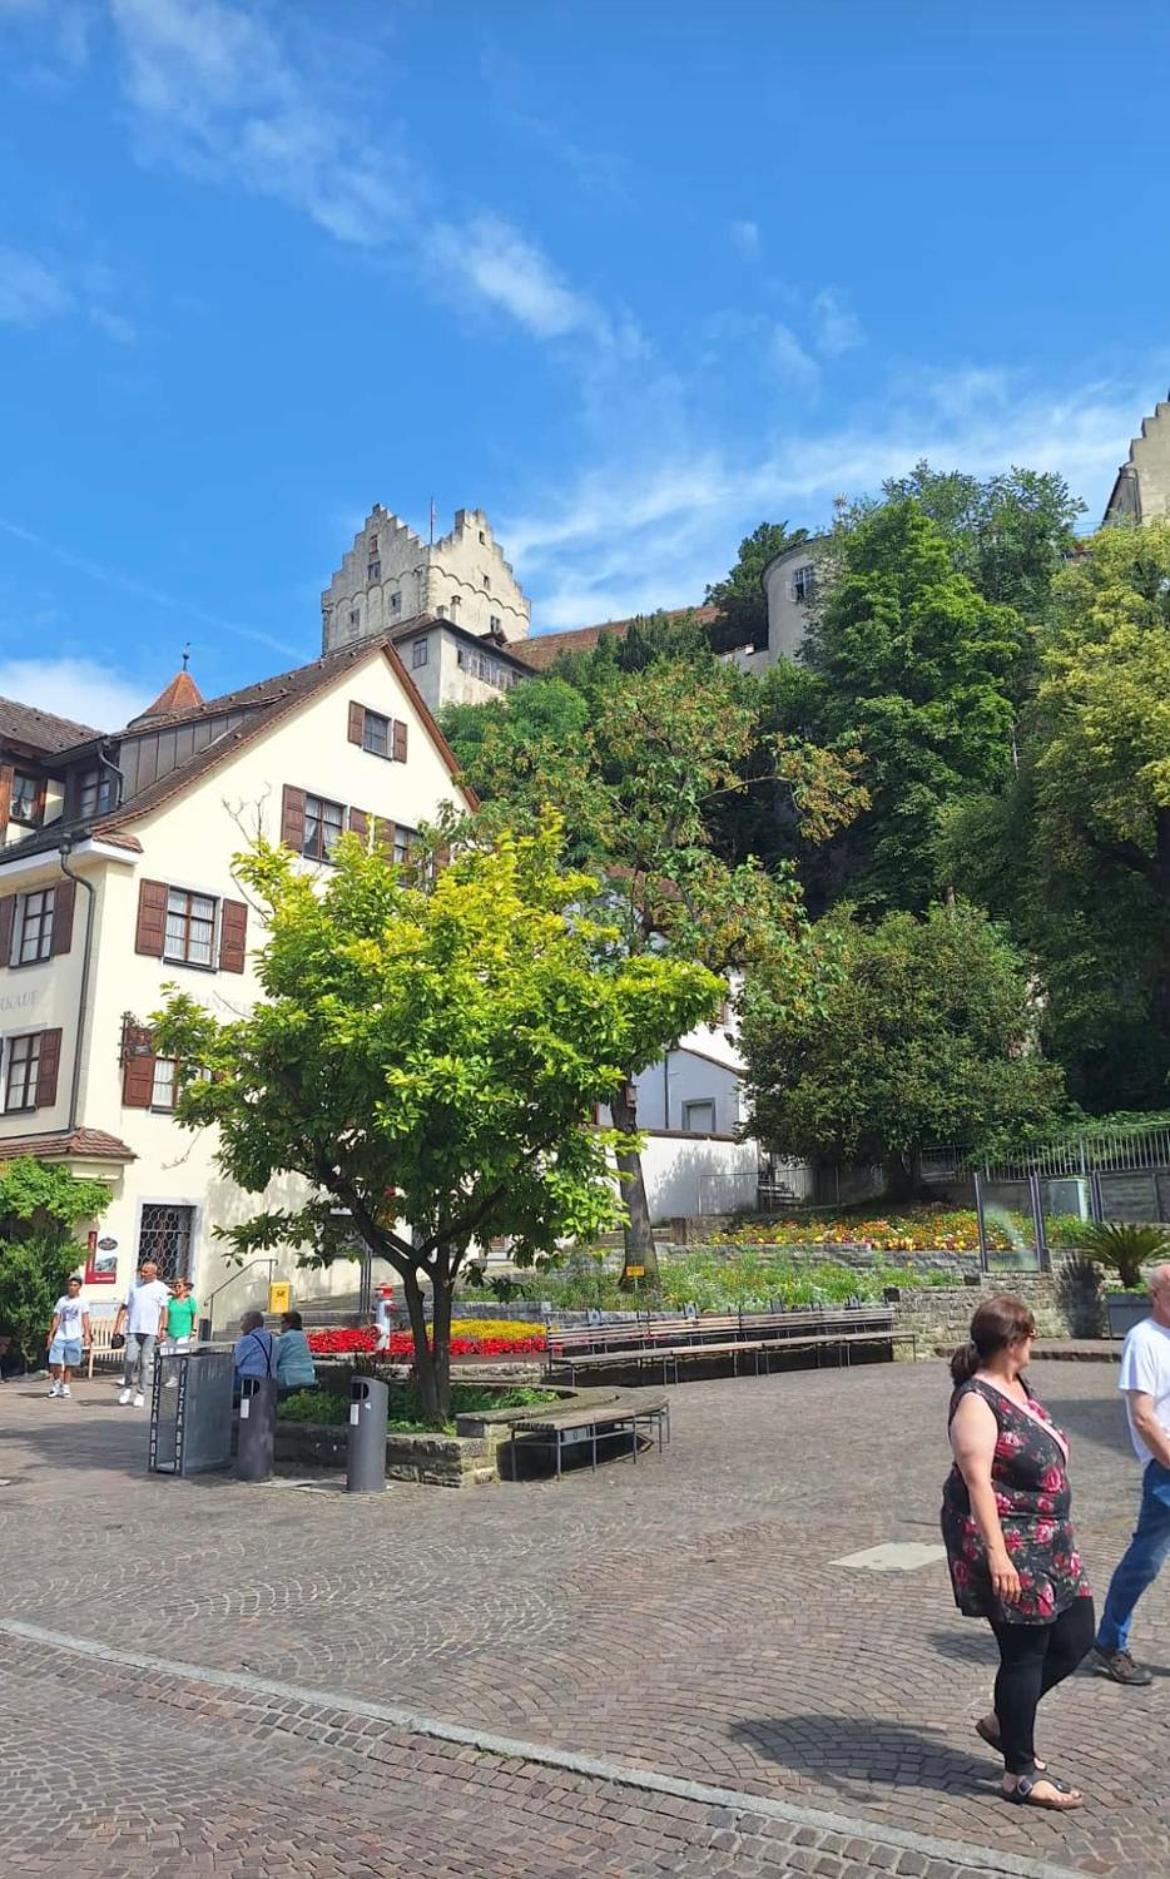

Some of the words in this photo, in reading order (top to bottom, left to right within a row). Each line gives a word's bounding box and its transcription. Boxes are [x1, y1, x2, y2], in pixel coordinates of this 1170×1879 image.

[152, 1359, 162, 1424] PIZZA
[177, 1359, 187, 1426] PIZZA
[149, 1428, 157, 1467] BOX
[174, 1431, 183, 1470] BOX
